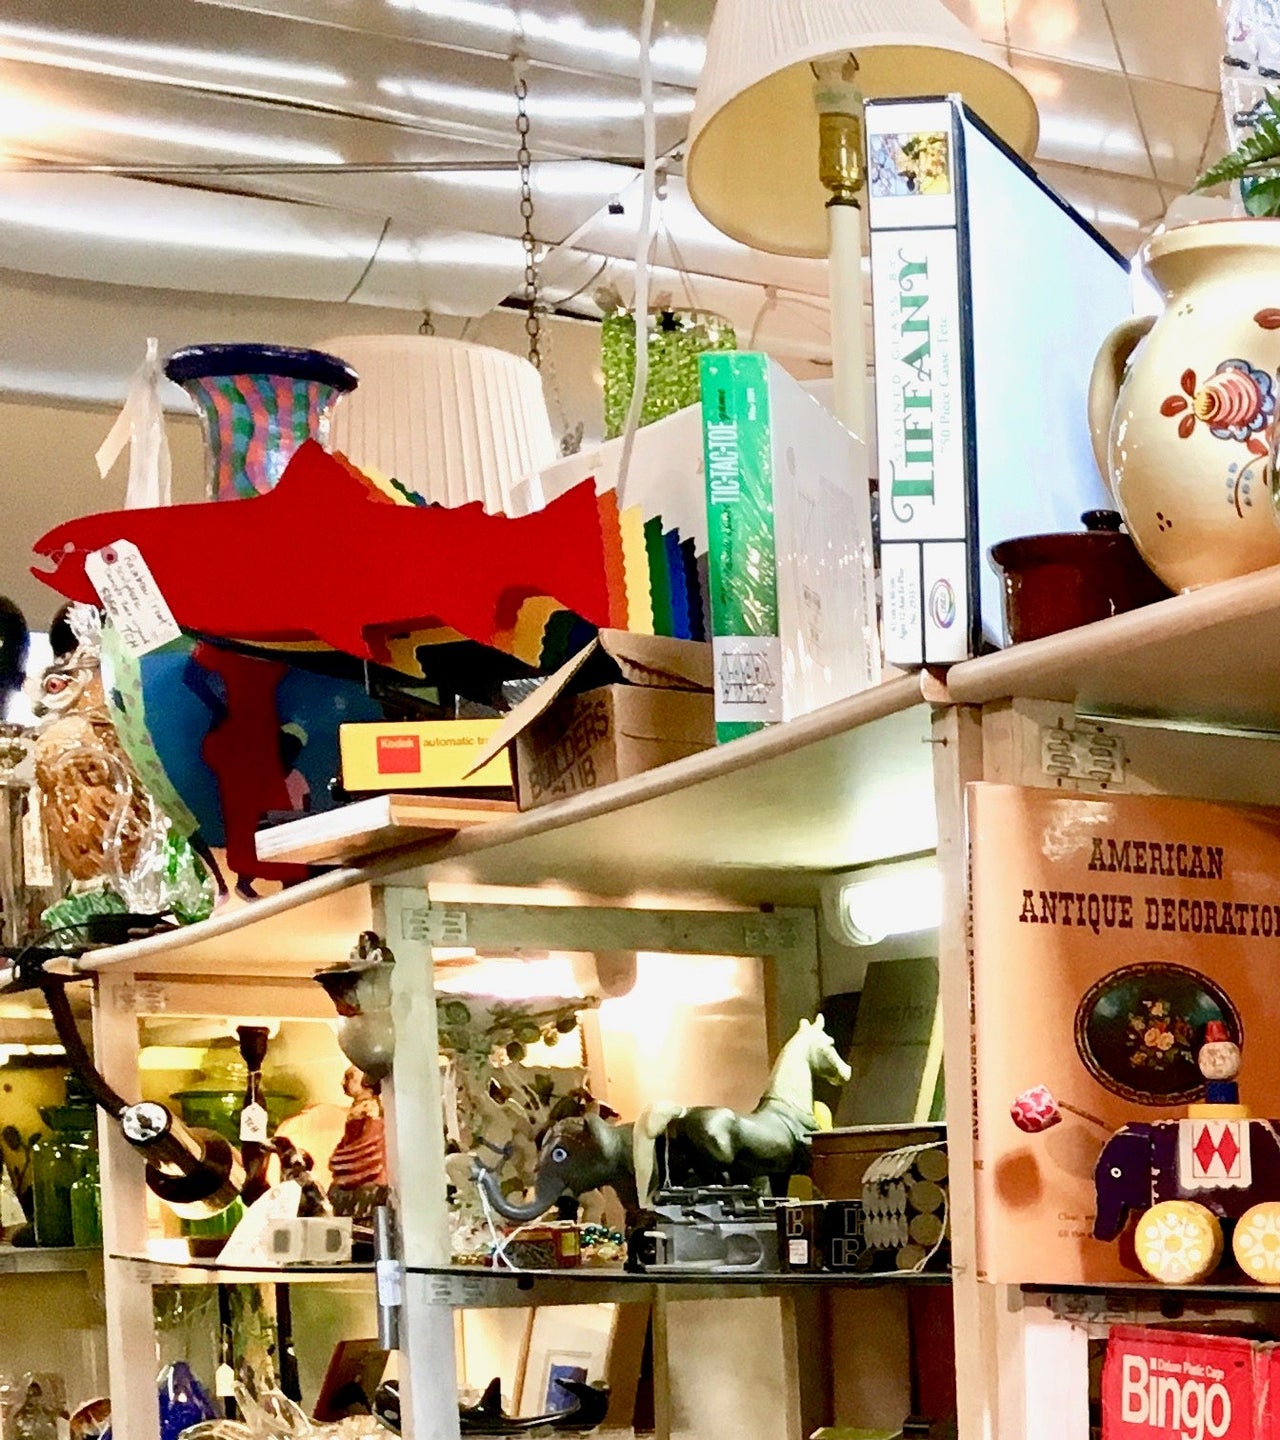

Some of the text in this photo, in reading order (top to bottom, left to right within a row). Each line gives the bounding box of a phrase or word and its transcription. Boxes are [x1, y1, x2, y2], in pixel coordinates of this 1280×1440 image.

[889, 248, 935, 524] TIFFANY
[380, 737, 415, 750] Kodak
[423, 737, 476, 748] automatic
[1088, 837, 1223, 880] AMERICAN
[1019, 889, 1133, 935] ANTIQUE
